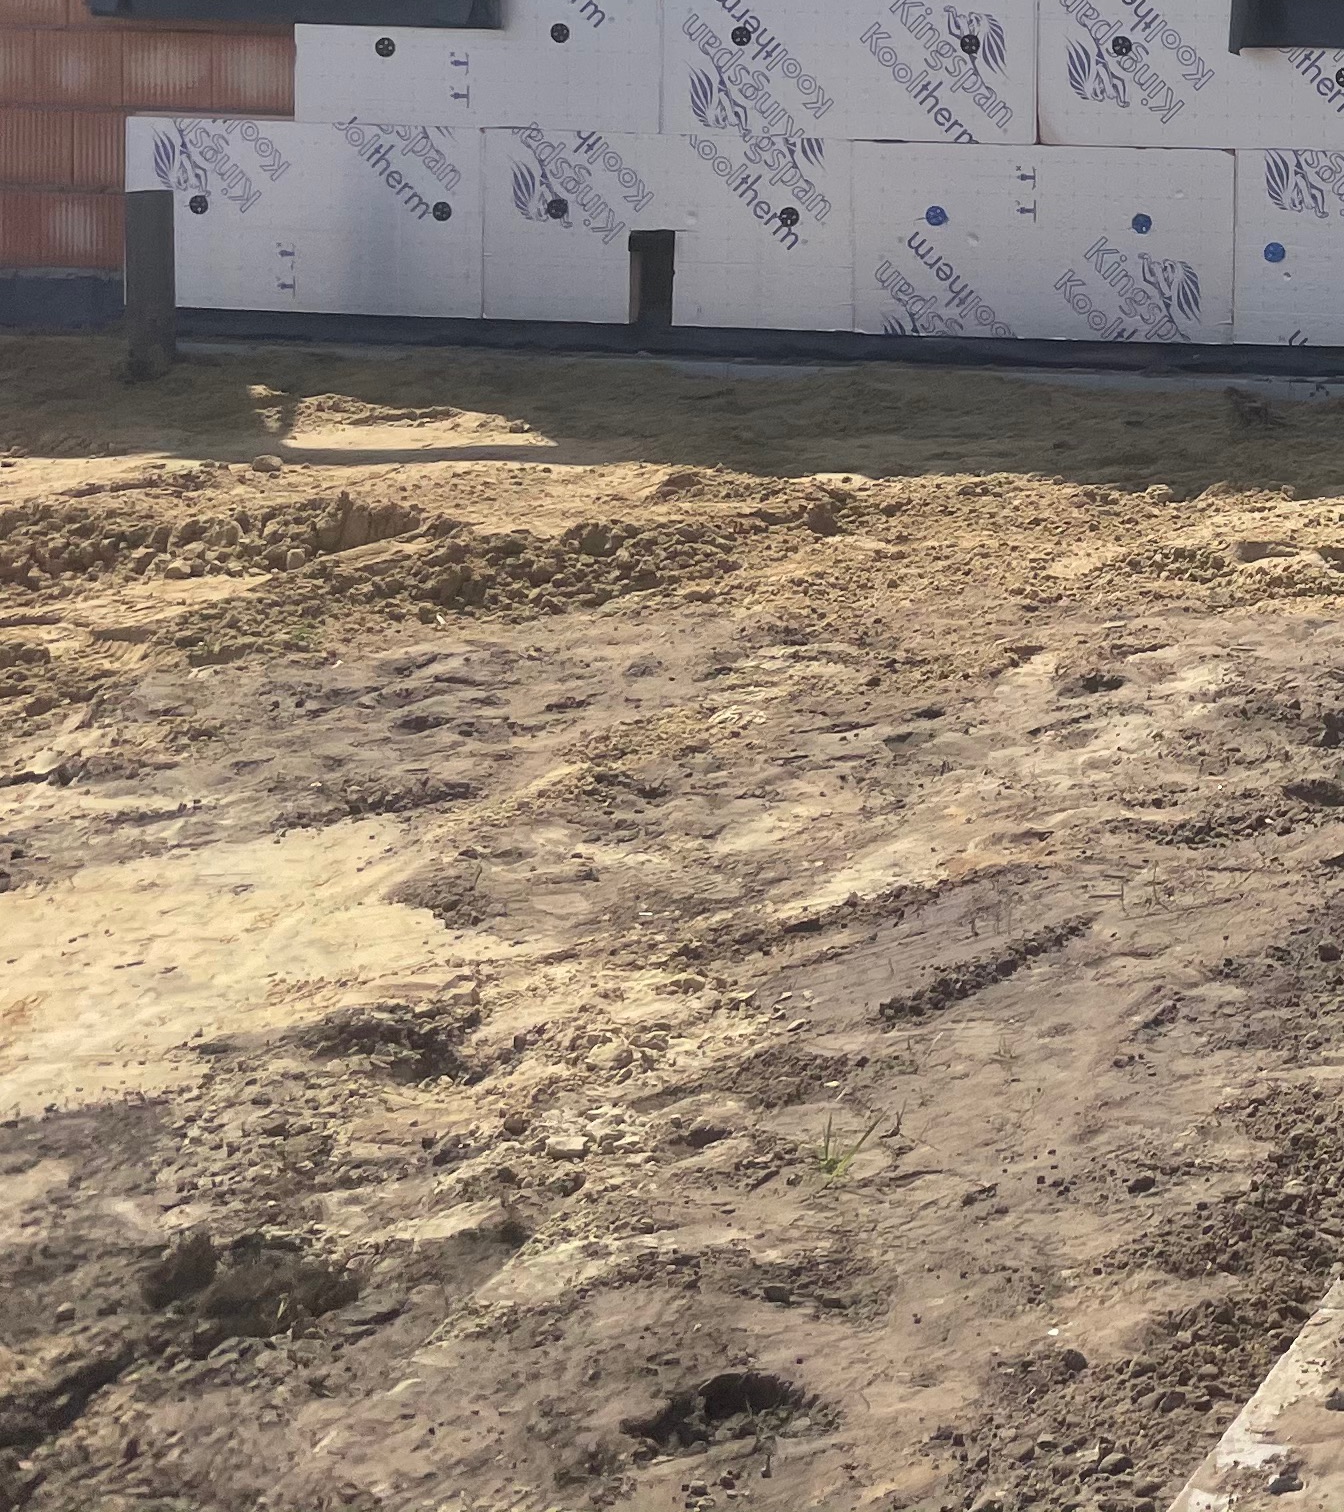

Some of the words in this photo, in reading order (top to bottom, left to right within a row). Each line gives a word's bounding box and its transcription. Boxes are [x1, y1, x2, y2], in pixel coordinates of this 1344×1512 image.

[174, 118, 262, 213] Kingsp
[333, 123, 430, 220] oltherm
[573, 131, 654, 213] Koolth
[690, 135, 799, 250] ooltherm
[907, 231, 1014, 338] ooltherm
[1084, 236, 1178, 340] Kingsp
